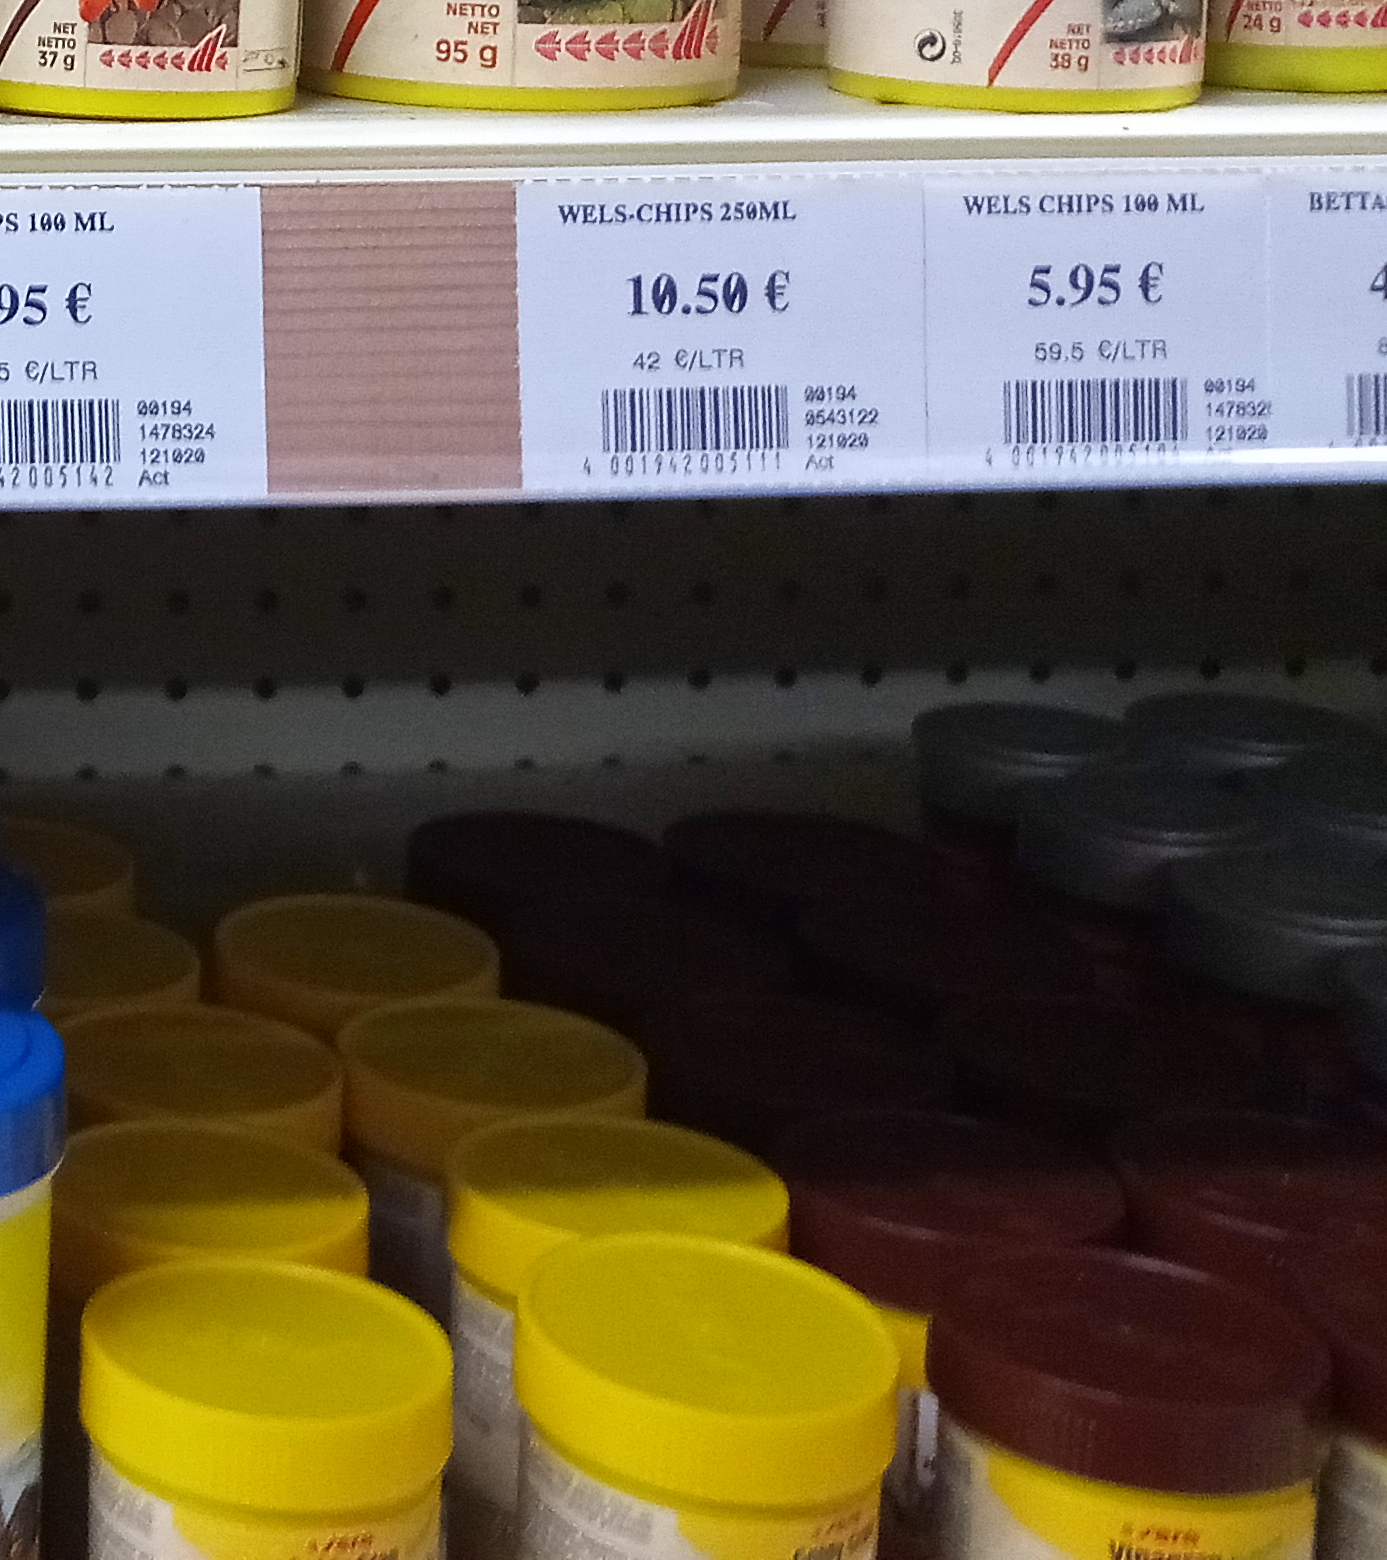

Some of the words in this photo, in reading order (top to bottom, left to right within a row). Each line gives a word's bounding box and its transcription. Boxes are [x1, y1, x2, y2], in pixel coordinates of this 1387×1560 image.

[446, 1, 501, 19] NETTO
[53, 22, 78, 35] NET
[467, 20, 500, 35] NET
[1242, 14, 1264, 31] 24
[1269, 15, 1282, 33] g
[38, 37, 76, 49] NETTO
[38, 51, 58, 69] 37
[63, 54, 75, 71] g
[435, 39, 469, 64] 95
[479, 44, 498, 69] g
[1050, 53, 1072, 69] 38
[1077, 55, 1089, 72] g
[557, 202, 713, 225] WELS-CHIPS
[720, 200, 797, 223] 250ML
[963, 194, 1032, 217] WELS
[1039, 193, 1115, 215] CHIPS
[1124, 193, 1160, 214] 100
[1167, 192, 1205, 213] ML
[29, 212, 67, 233] 100
[74, 211, 115, 233] ML
[626, 271, 749, 317] 10.50
[764, 269, 791, 313] €
[1027, 263, 1122, 308] 5.95
[1138, 261, 1165, 305] €
[64, 281, 93, 325] €
[632, 351, 661, 371] 42
[674, 347, 745, 373] €/LTR
[1034, 342, 1085, 362] 59.5
[25, 360, 98, 385] €/LTR
[804, 385, 857, 402] 00194
[136, 399, 193, 417] 00194
[805, 408, 879, 425] 0543122
[139, 423, 216, 441] 1478324
[139, 448, 206, 465] 121020
[138, 468, 170, 487] Act
